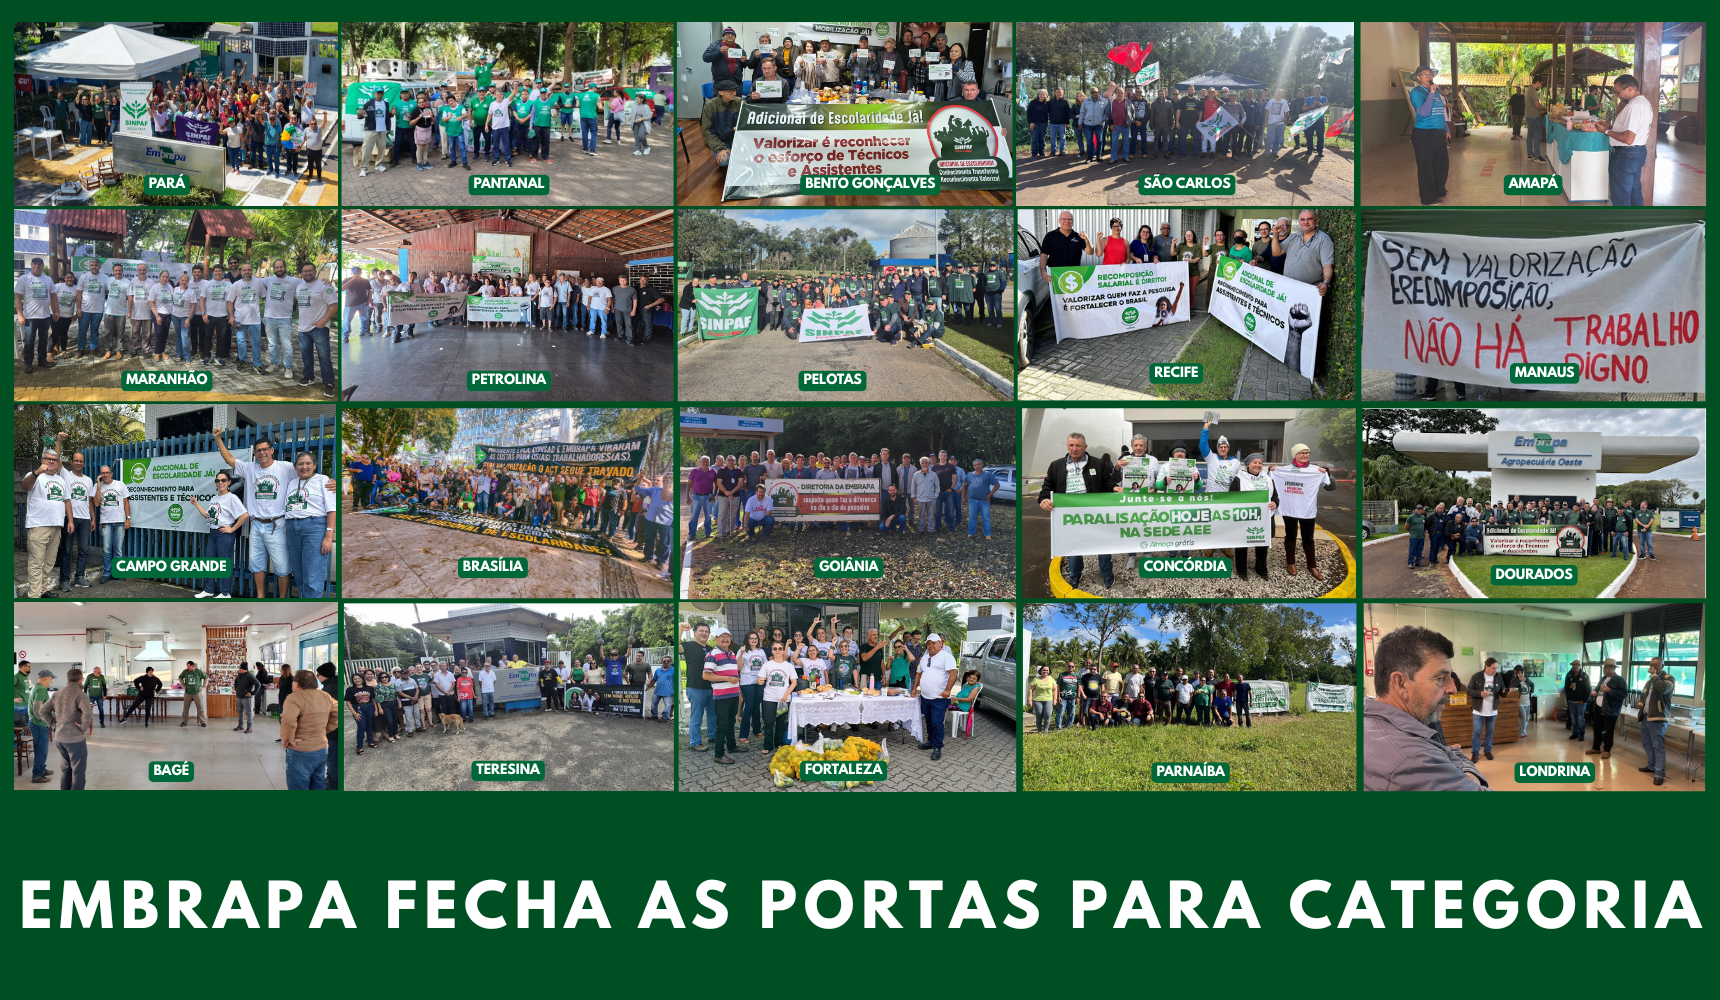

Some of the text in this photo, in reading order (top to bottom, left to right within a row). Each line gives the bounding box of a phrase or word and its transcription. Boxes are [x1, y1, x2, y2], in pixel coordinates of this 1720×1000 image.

[747, 110, 924, 124] Adicional de Escolaridade Já!
[186, 131, 212, 141] SINPAF
[754, 136, 910, 149] Valorizar é reconhecer
[146, 147, 186, 162] Embrapa
[754, 149, 909, 164] o esforço de Técnicos
[788, 164, 882, 177] e Assistentes
[1382, 238, 1637, 280] SEM VALORIZAÇÃO
[1098, 270, 1154, 281] RECOMPOSIÇÃO
[1241, 270, 1274, 288] ADICIONAL DE
[1098, 280, 1133, 288] SALARIAL
[1240, 277, 1287, 302] ESCOLARIDADE JÁ!
[1063, 293, 1105, 303] VALORIZAR
[1148, 286, 1176, 294] PESQUISA
[1063, 303, 1068, 311] É
[1070, 302, 1117, 311] FORTALECER
[1216, 287, 1247, 307] ASSISTENTES
[1253, 305, 1285, 329] TÉCNICOS
[1254, 298, 1267, 309] PARA
[700, 316, 751, 330] SINPAF
[1404, 310, 1699, 369] NÃO HÁ TRABALHO
[1514, 436, 1568, 448] Embrapa
[1501, 457, 1582, 466] Agropecuária Oeste
[153, 469, 215, 479] ESCOLARIDADE JÁ!
[1120, 495, 1172, 503] Junte-se
[1189, 494, 1214, 502] nós!
[1063, 508, 1261, 526] PARALISAÇÃO HOJE AS 10H,
[1120, 525, 1211, 538] NA SEDE AEE
[1149, 540, 1194, 549] Almoço grátis
